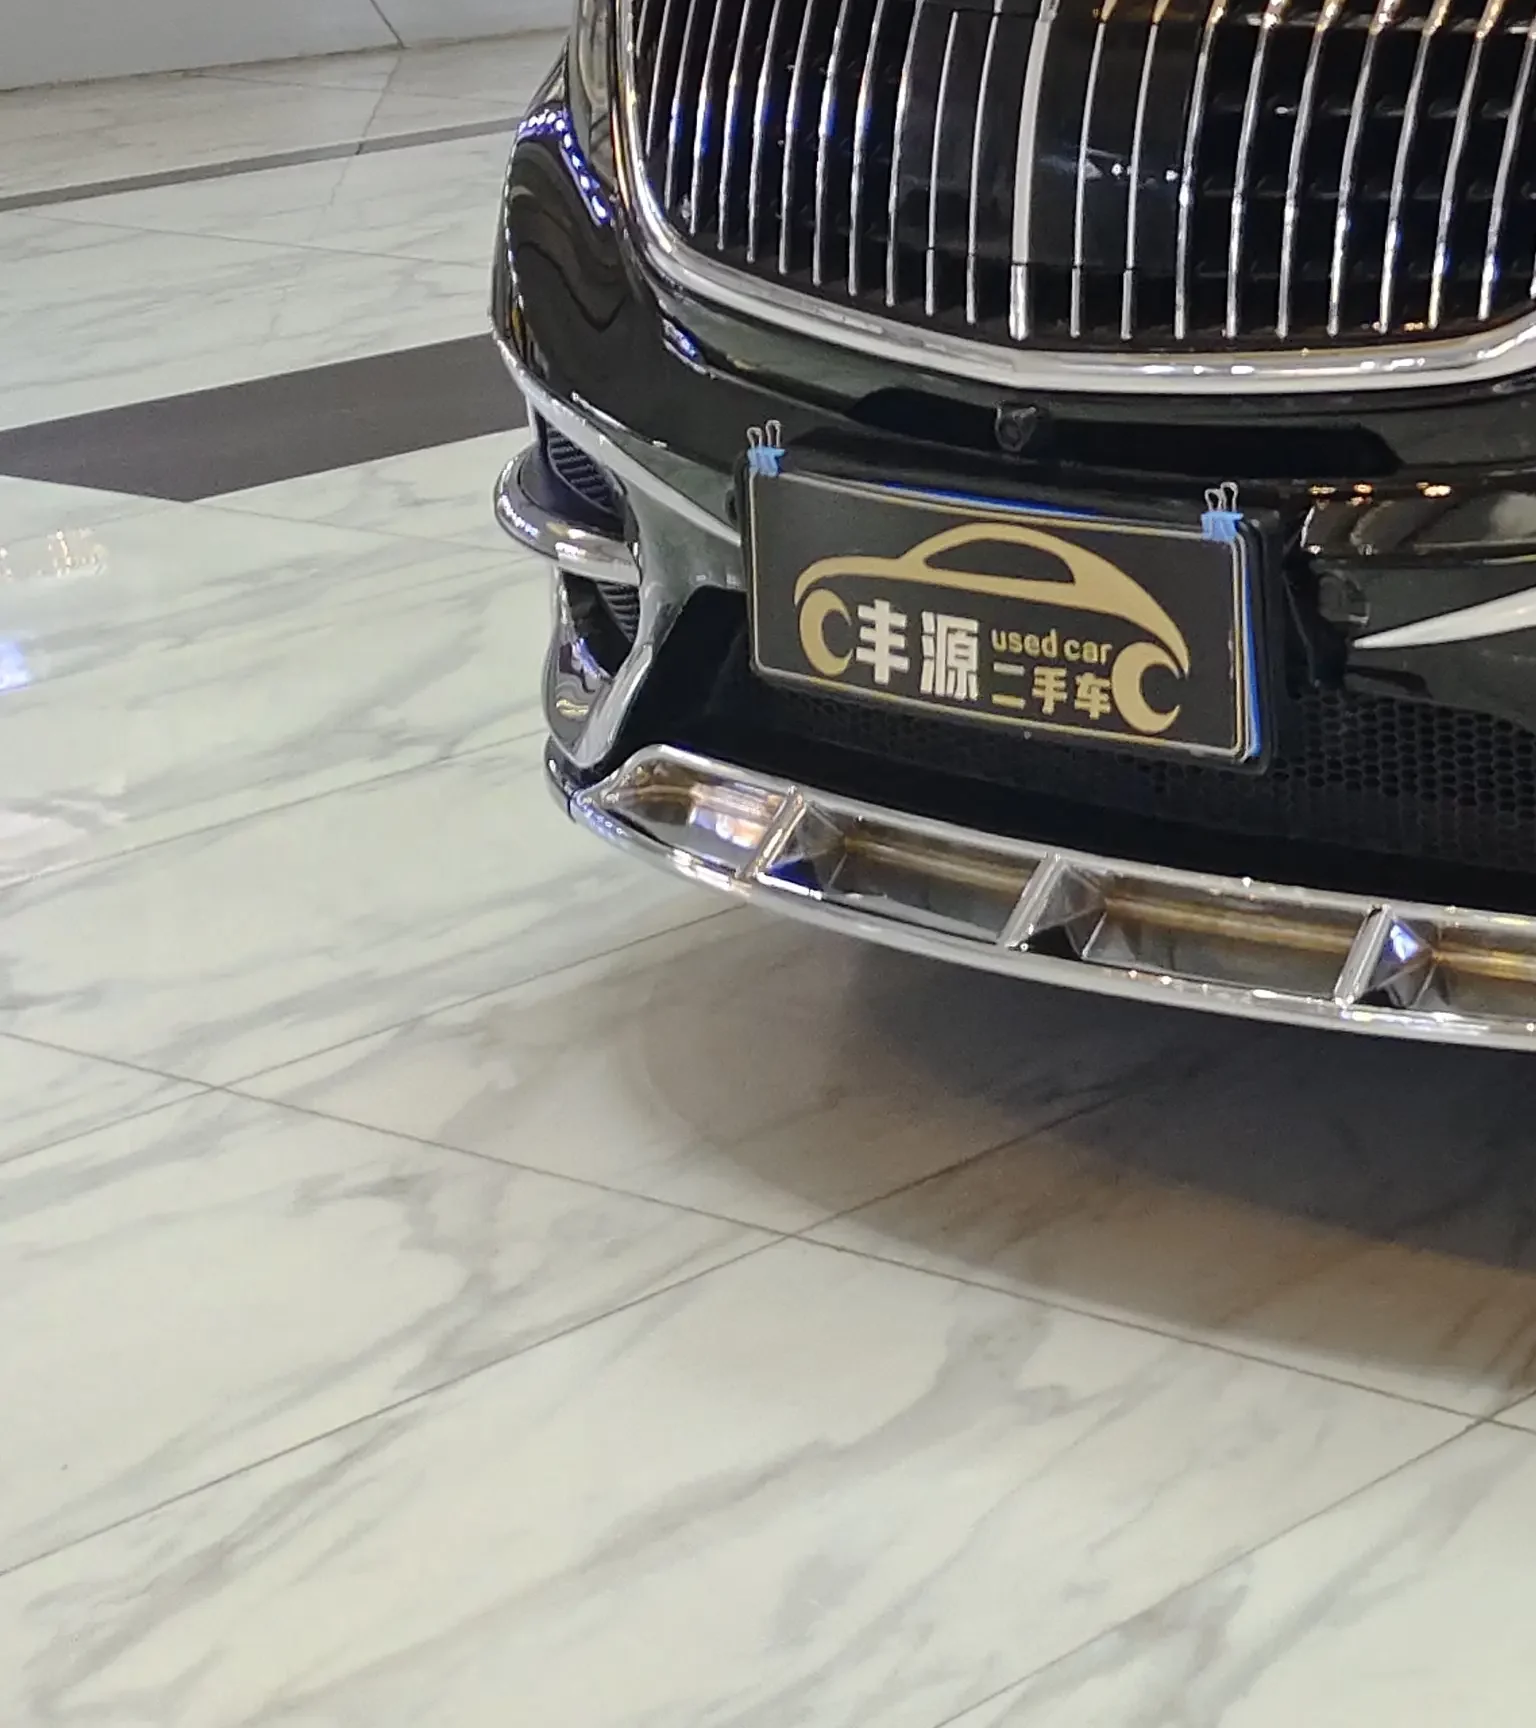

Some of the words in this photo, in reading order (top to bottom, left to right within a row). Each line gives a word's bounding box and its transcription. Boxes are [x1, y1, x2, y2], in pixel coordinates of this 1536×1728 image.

[855, 599, 981, 701] 丰源
[991, 628, 1058, 659] used
[1063, 639, 1112, 665] car
[992, 661, 1113, 720] 二手车
